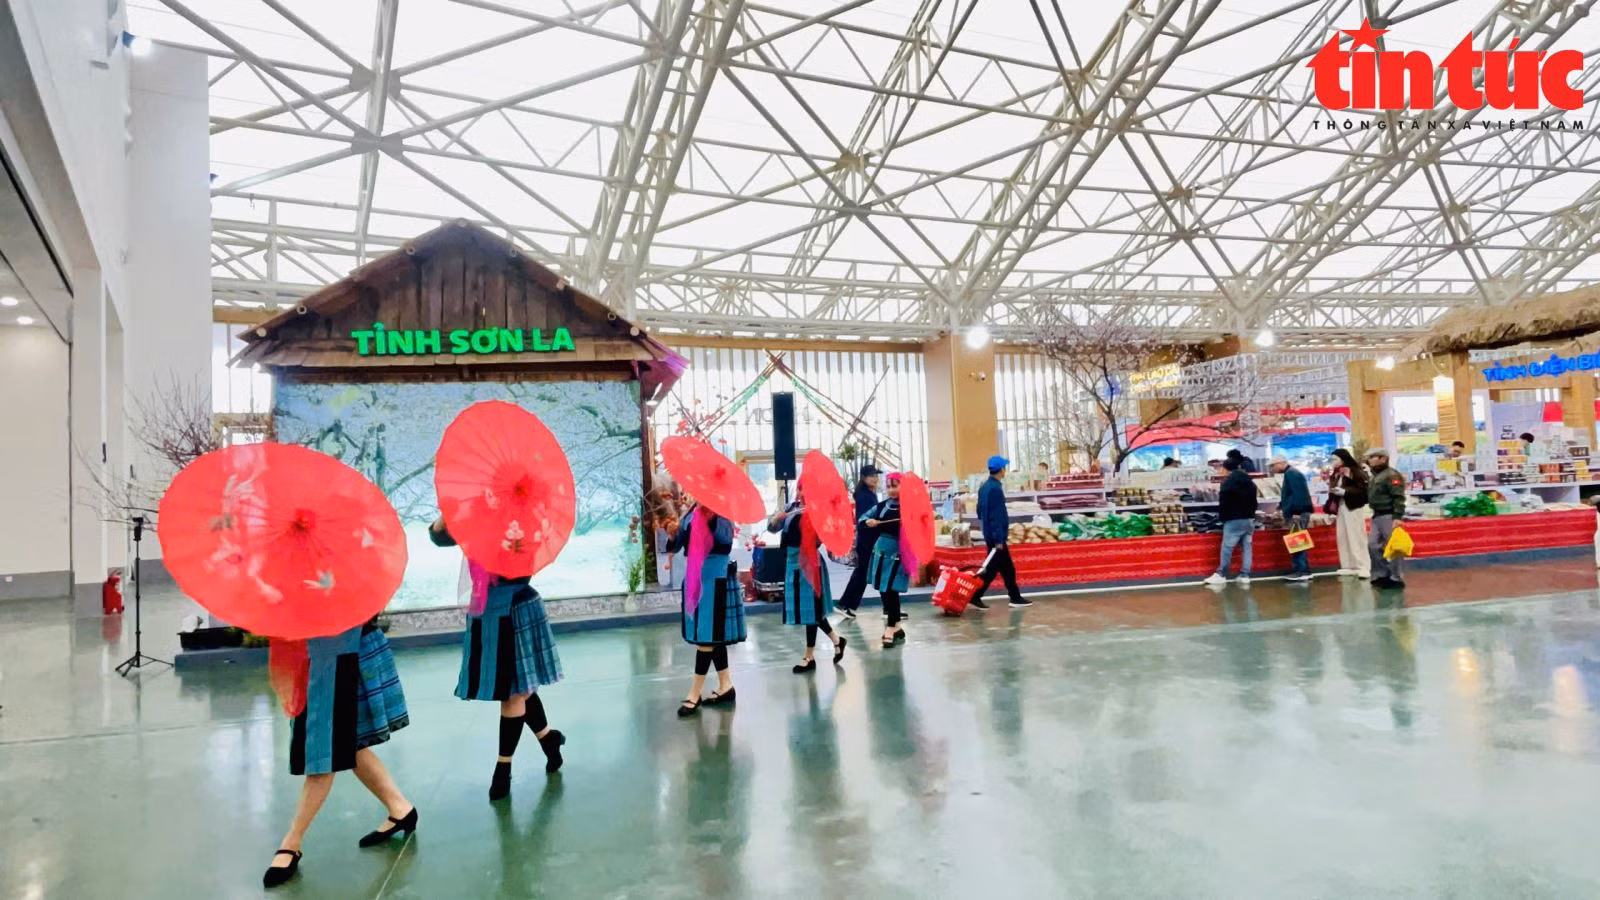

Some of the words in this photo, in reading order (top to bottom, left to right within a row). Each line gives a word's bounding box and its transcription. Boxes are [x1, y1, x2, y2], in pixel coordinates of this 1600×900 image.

[351, 321, 441, 355] TỈNH
[450, 326, 523, 354] SƠN
[532, 327, 576, 351] LA
[1483, 361, 1526, 382] TỈNH
